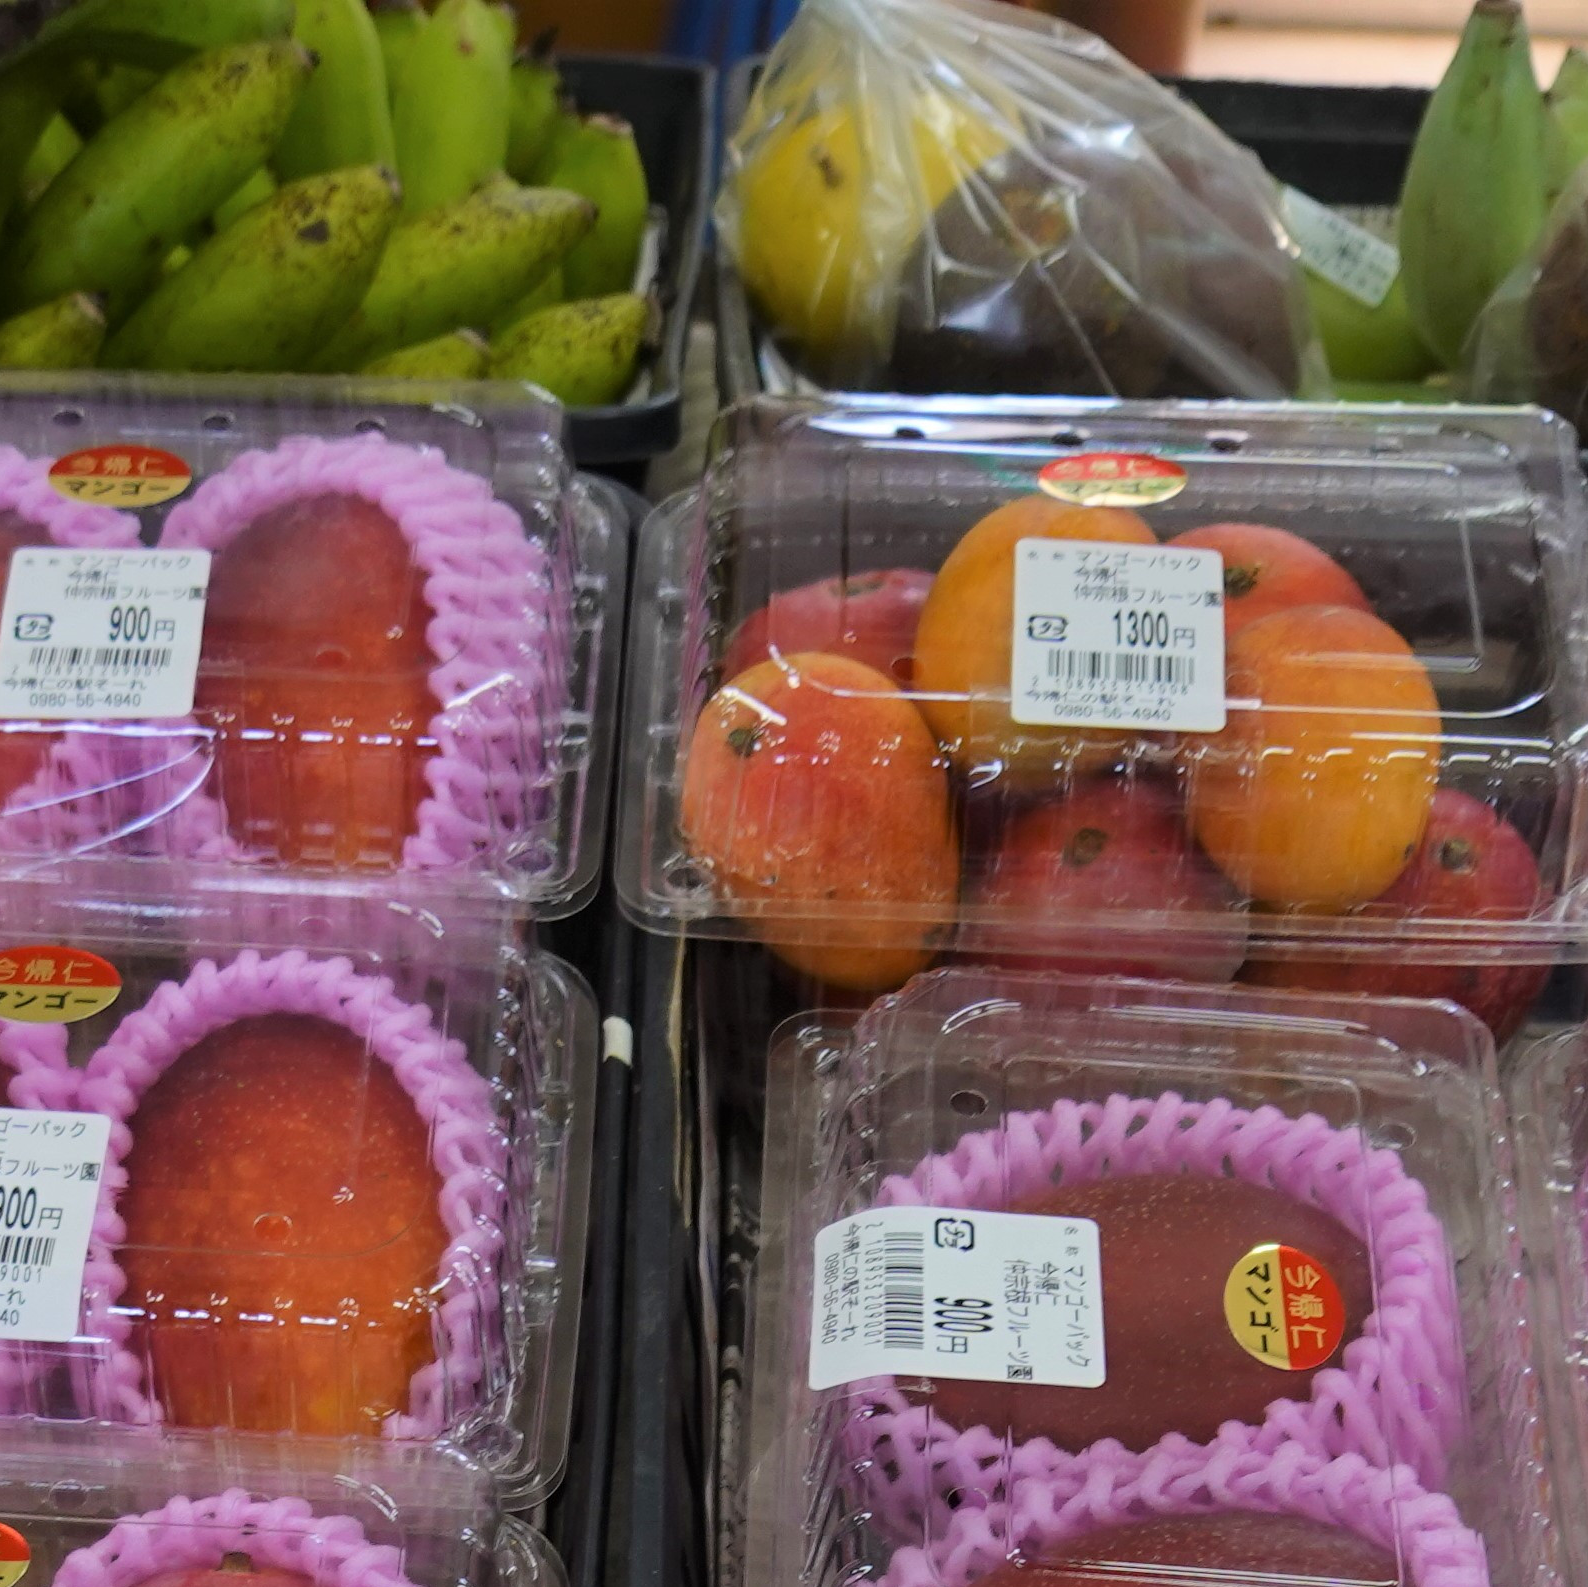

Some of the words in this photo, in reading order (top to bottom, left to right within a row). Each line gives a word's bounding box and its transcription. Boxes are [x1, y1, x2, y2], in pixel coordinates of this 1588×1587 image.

[110, 606, 175, 642] 900円
[1113, 608, 1195, 649] 1300円
[932, 1295, 994, 1355] 900円
[1246, 1260, 1270, 1354] マンゴー
[1284, 1262, 1327, 1351] 今帰仁
